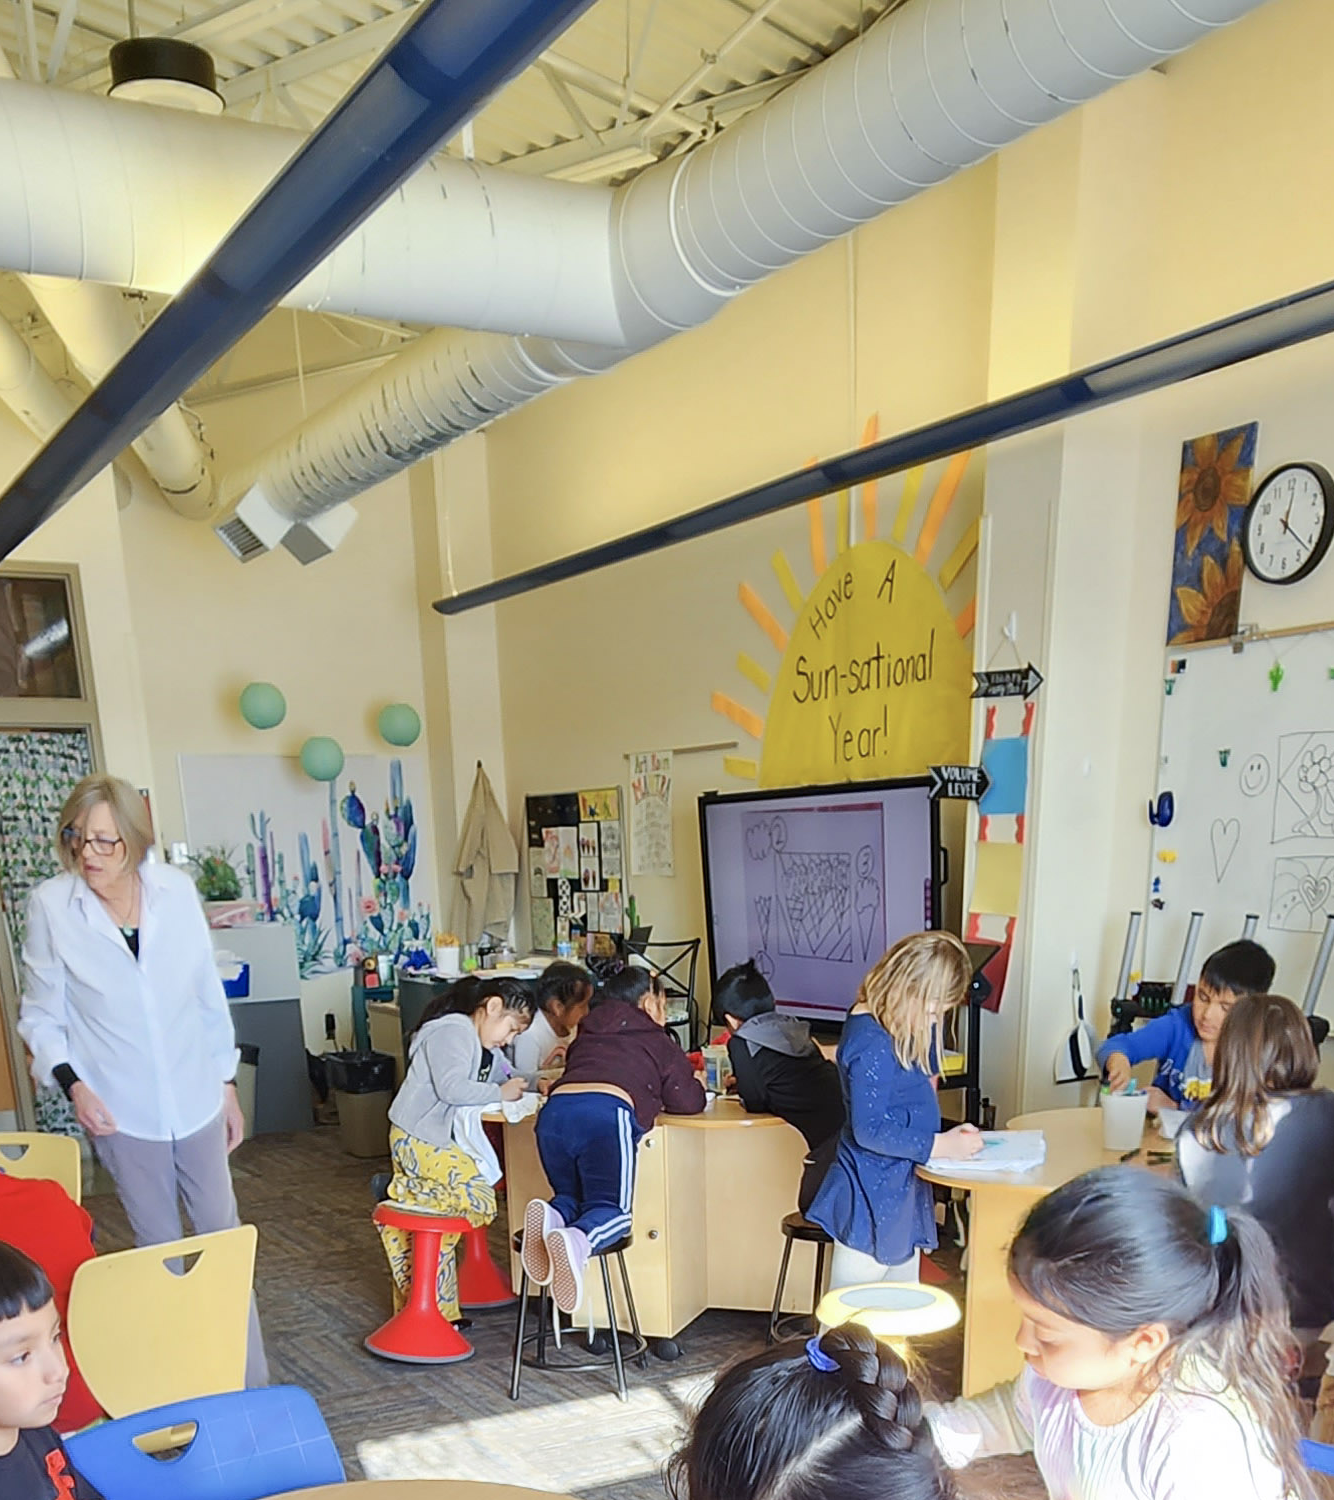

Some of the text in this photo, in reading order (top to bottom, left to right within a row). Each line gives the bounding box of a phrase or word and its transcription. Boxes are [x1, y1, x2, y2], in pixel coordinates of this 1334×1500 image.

[809, 559, 896, 640] Have A
[793, 628, 935, 703] Sun-sational
[828, 704, 888, 764] Year!
[941, 766, 982, 782] VOLUME
[948, 782, 979, 797] LEVEL
